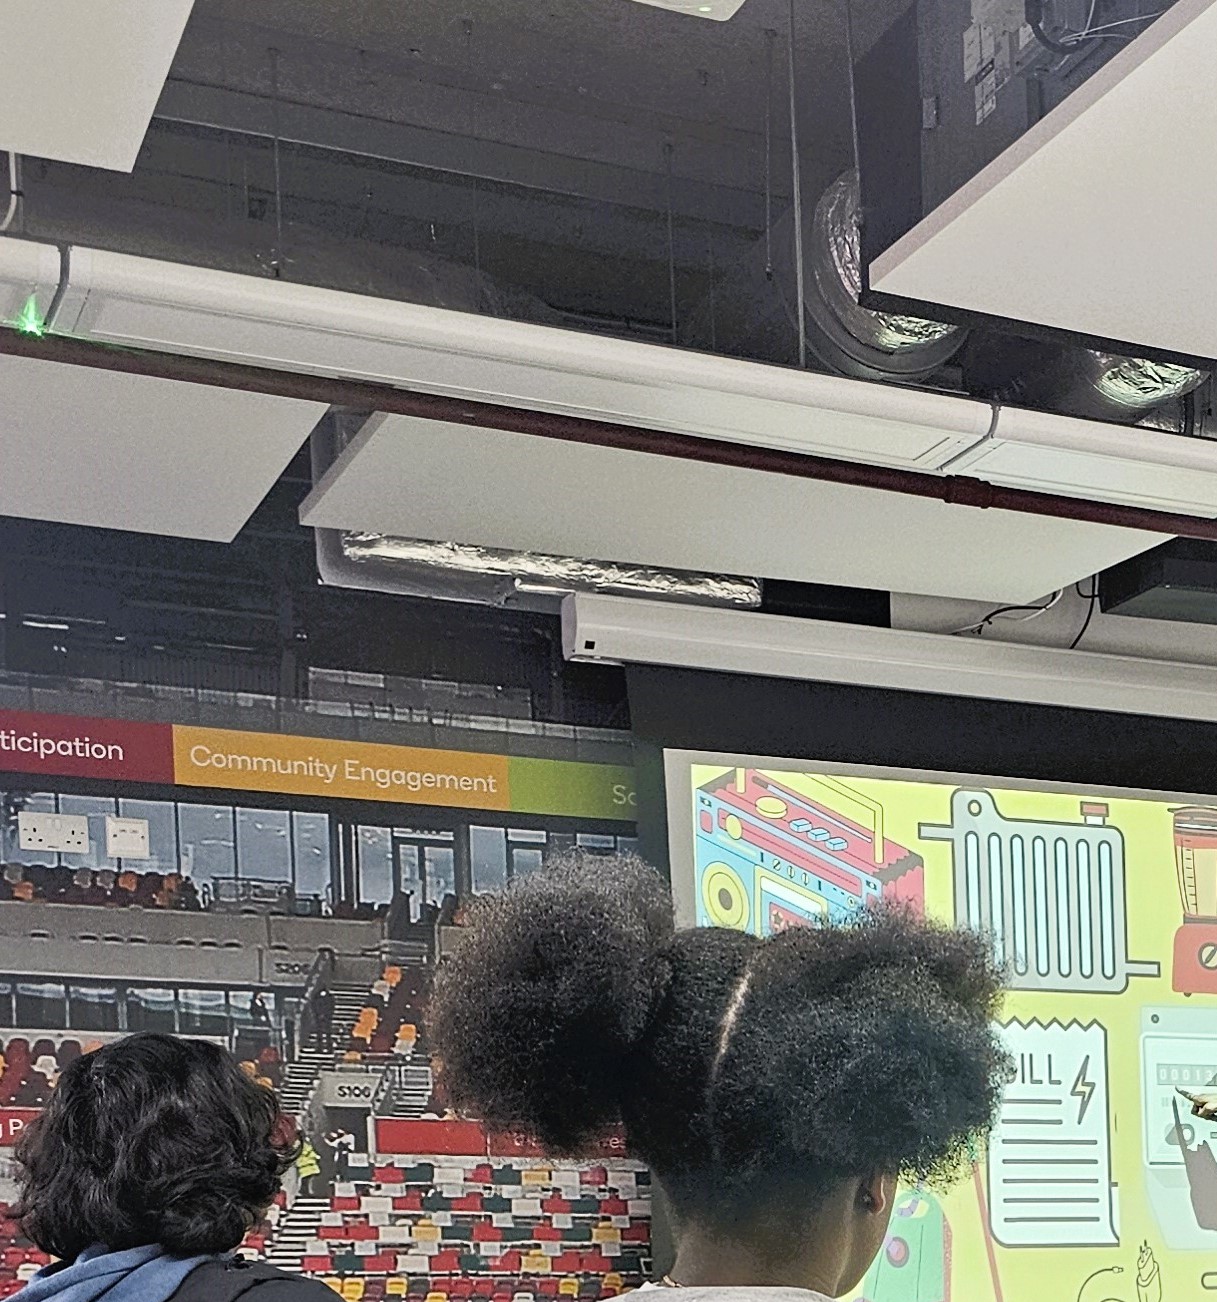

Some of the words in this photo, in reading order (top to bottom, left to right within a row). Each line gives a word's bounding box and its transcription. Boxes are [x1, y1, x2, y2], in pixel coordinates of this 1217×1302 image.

[0, 729, 124, 762] ticipation
[190, 745, 338, 784] Community
[344, 759, 497, 793] Engagement
